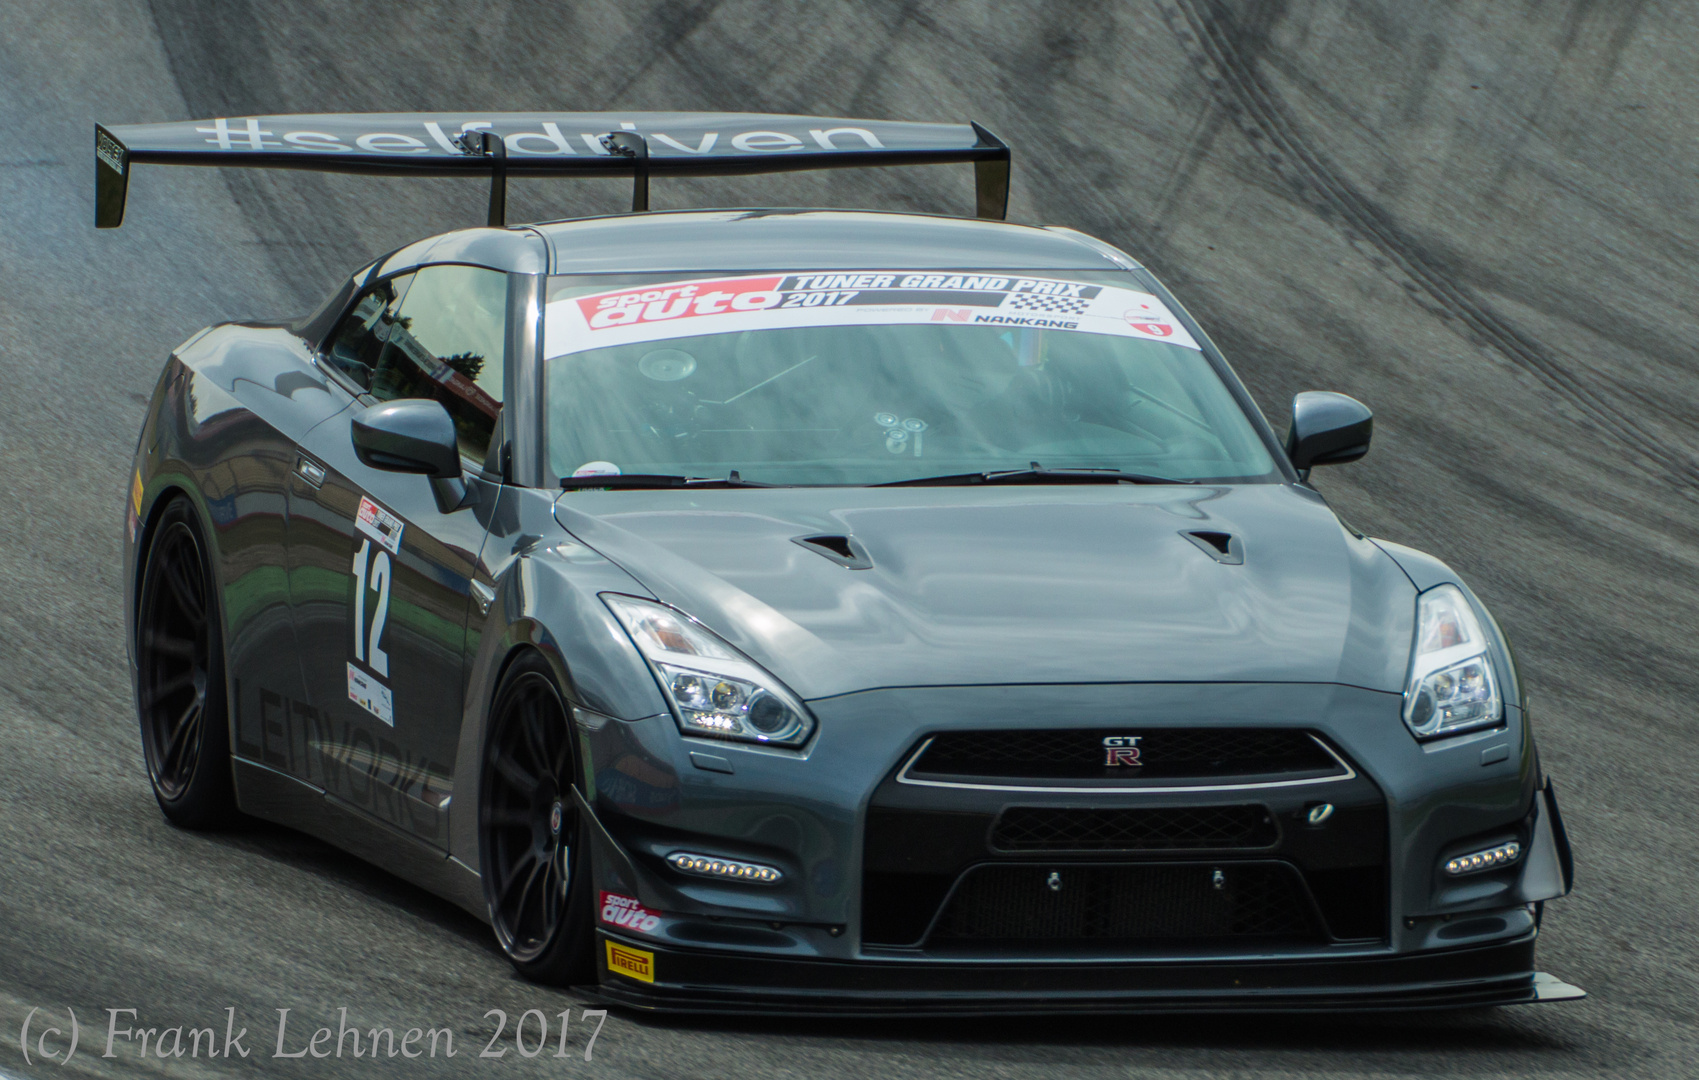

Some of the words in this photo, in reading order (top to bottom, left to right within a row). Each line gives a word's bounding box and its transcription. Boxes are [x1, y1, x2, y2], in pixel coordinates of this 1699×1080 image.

[796, 274, 896, 290] TUNER
[900, 275, 1010, 291] GRAND
[1012, 278, 1089, 297] PRIX
[590, 290, 782, 328] auto
[597, 285, 699, 310] sport
[788, 291, 860, 308] 2017
[974, 315, 1079, 330] NANKANG
[352, 538, 390, 678] 12
[1103, 736, 1142, 746] GT
[1104, 747, 1143, 766] R
[605, 894, 639, 909] sport
[602, 904, 660, 931] auto
[611, 946, 649, 976] PIRELLI
